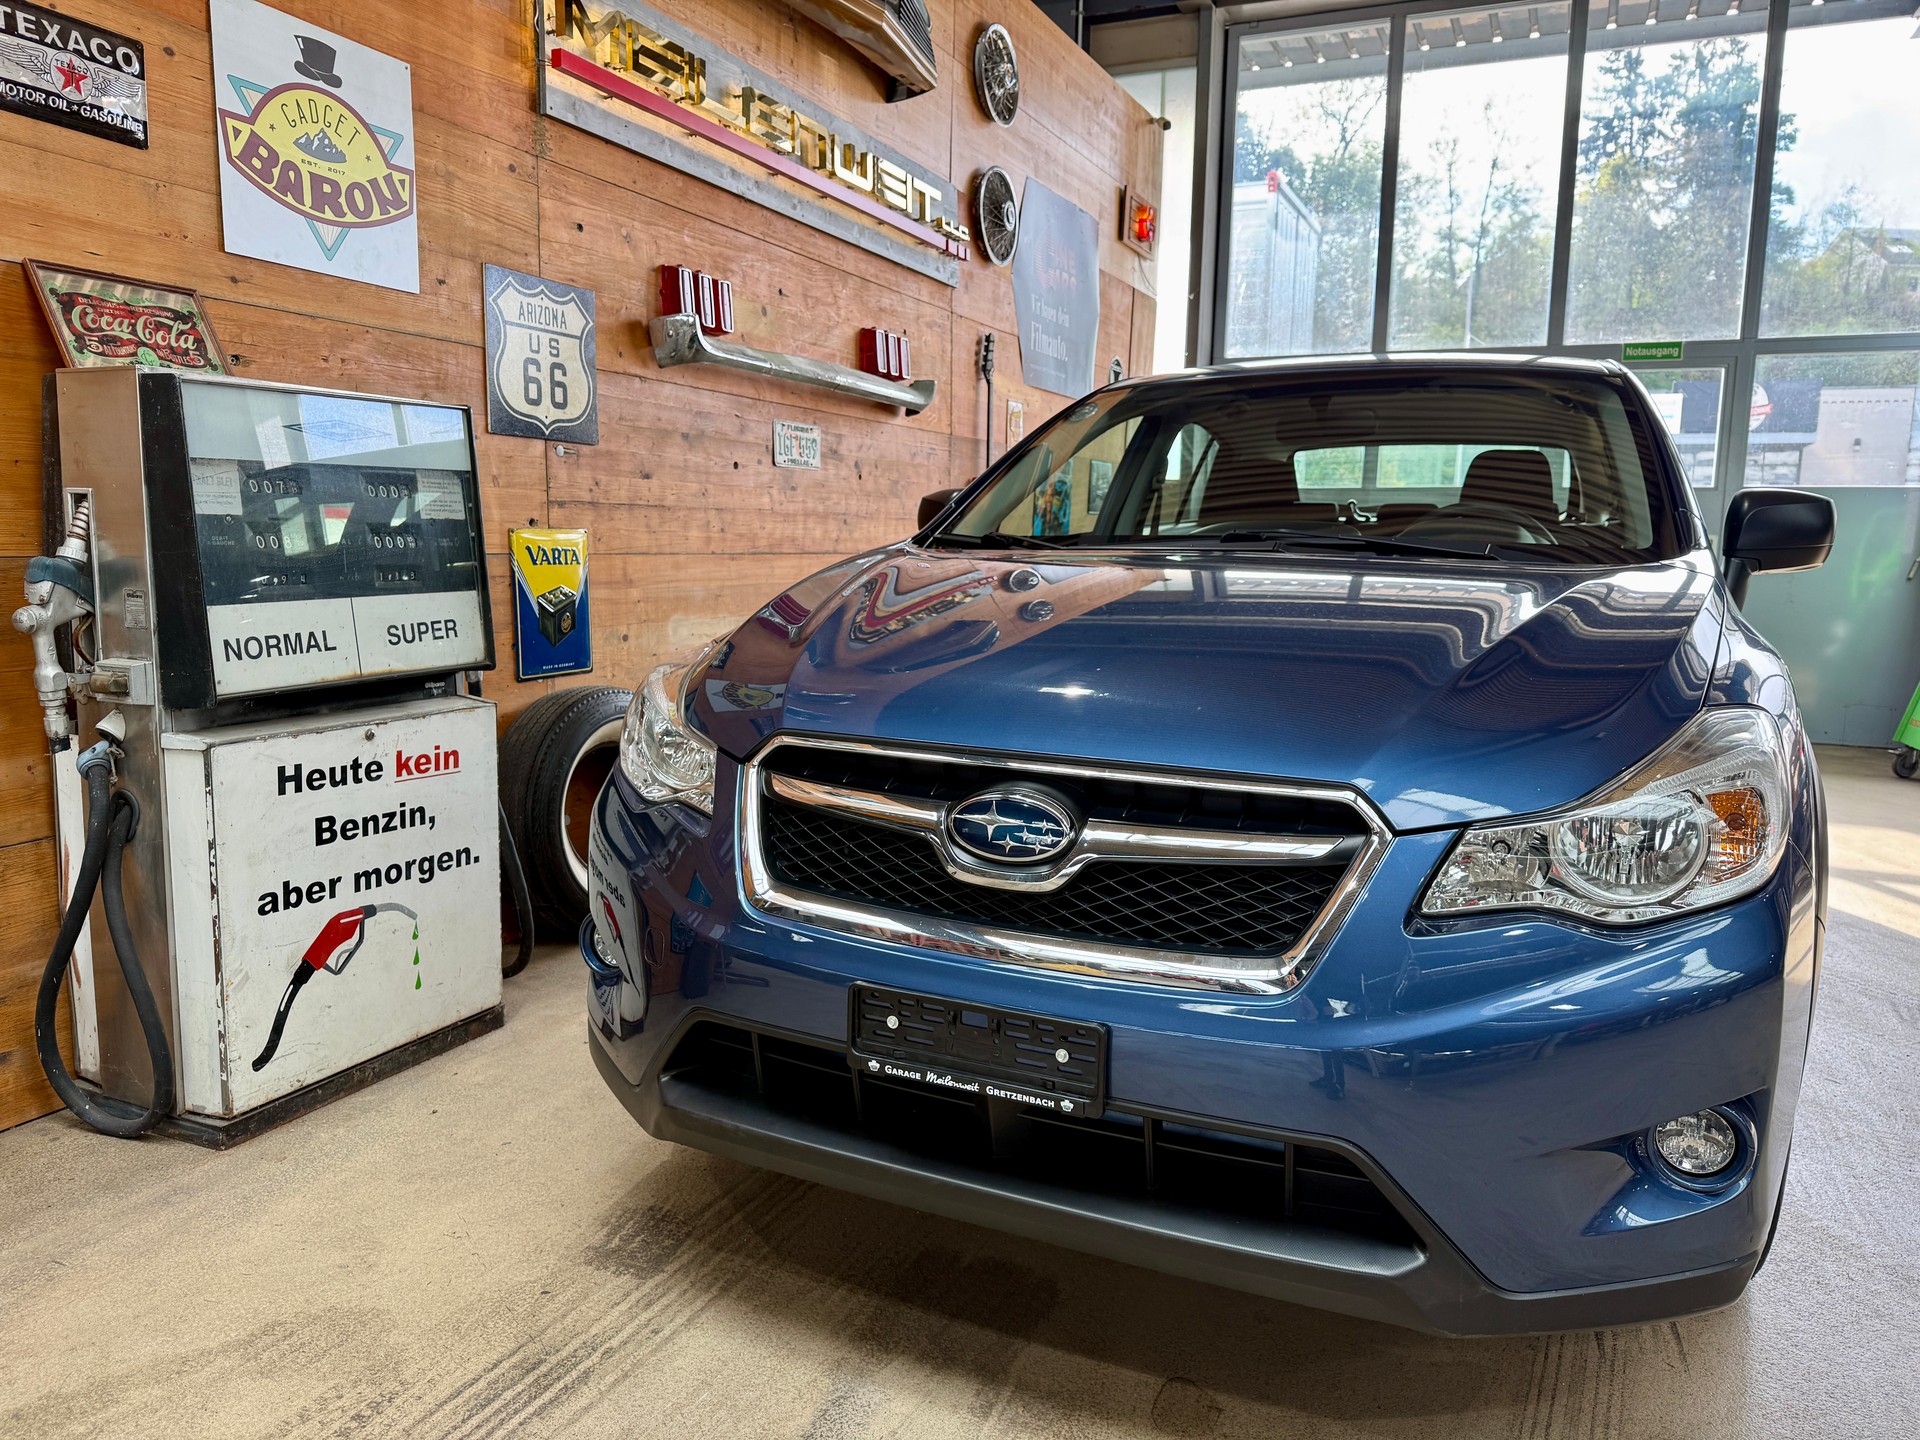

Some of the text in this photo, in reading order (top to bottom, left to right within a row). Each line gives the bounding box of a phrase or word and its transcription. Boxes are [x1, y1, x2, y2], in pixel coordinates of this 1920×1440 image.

[0, 4, 140, 76] TEXACO
[55, 59, 89, 75] TEXACO
[49, 95, 70, 112] OIL
[280, 98, 361, 146] GADGET
[234, 127, 408, 220] BARON
[301, 158, 346, 176] EST. 2017
[78, 296, 120, 309] DELICIOUS
[518, 300, 568, 330] ARIZONA
[71, 304, 198, 350] Coca-Cola
[1625, 345, 1680, 357] Notausgang
[522, 356, 568, 411] 66
[524, 544, 581, 566] VARTA
[223, 629, 337, 662] NORMAL
[386, 618, 458, 646] SUPER
[276, 745, 461, 797] Heute kein
[314, 801, 436, 847] Benzin,
[256, 847, 481, 917] aber morgen.
[884, 1064, 922, 1080] GARAGE
[985, 1085, 1055, 1108] GRETZENBACH
